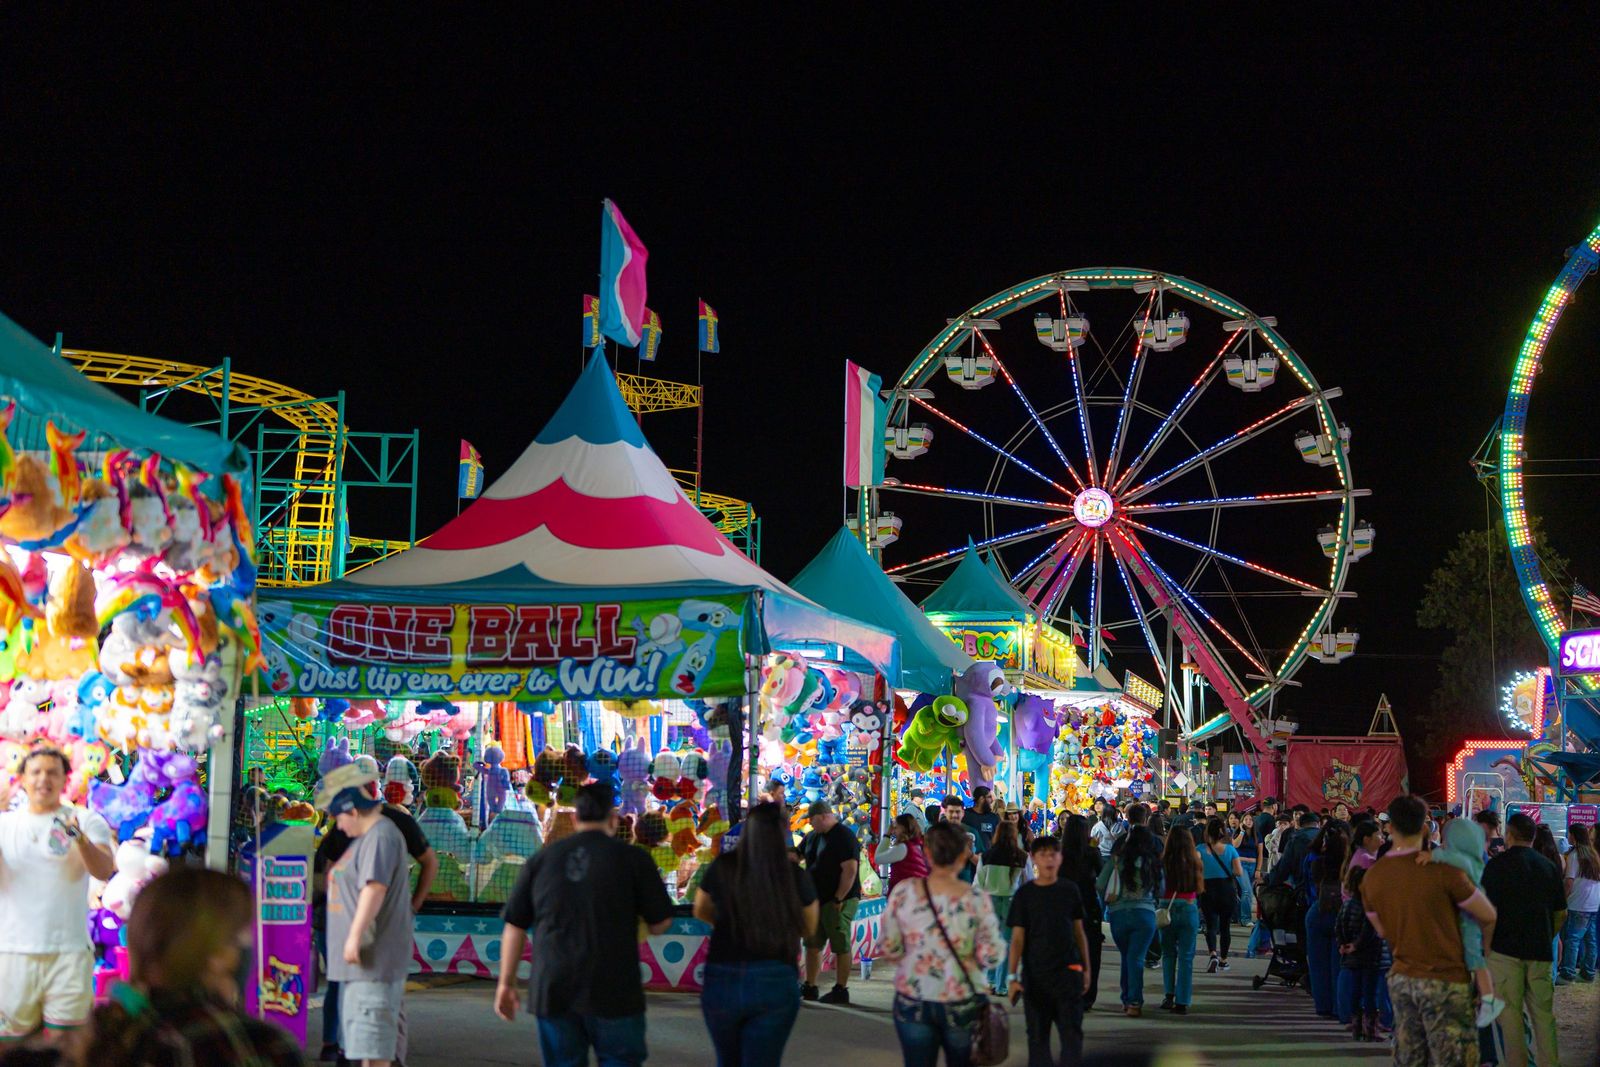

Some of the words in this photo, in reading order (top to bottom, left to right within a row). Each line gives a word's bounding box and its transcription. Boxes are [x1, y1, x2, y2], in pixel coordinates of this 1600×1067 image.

[329, 604, 454, 660] ONE
[467, 604, 637, 661] BALL
[964, 632, 1017, 657] BOX
[299, 663, 360, 692] Just
[459, 673, 520, 691] over
[528, 668, 555, 691] to
[560, 651, 663, 695] Win!
[266, 881, 302, 899] SOLD
